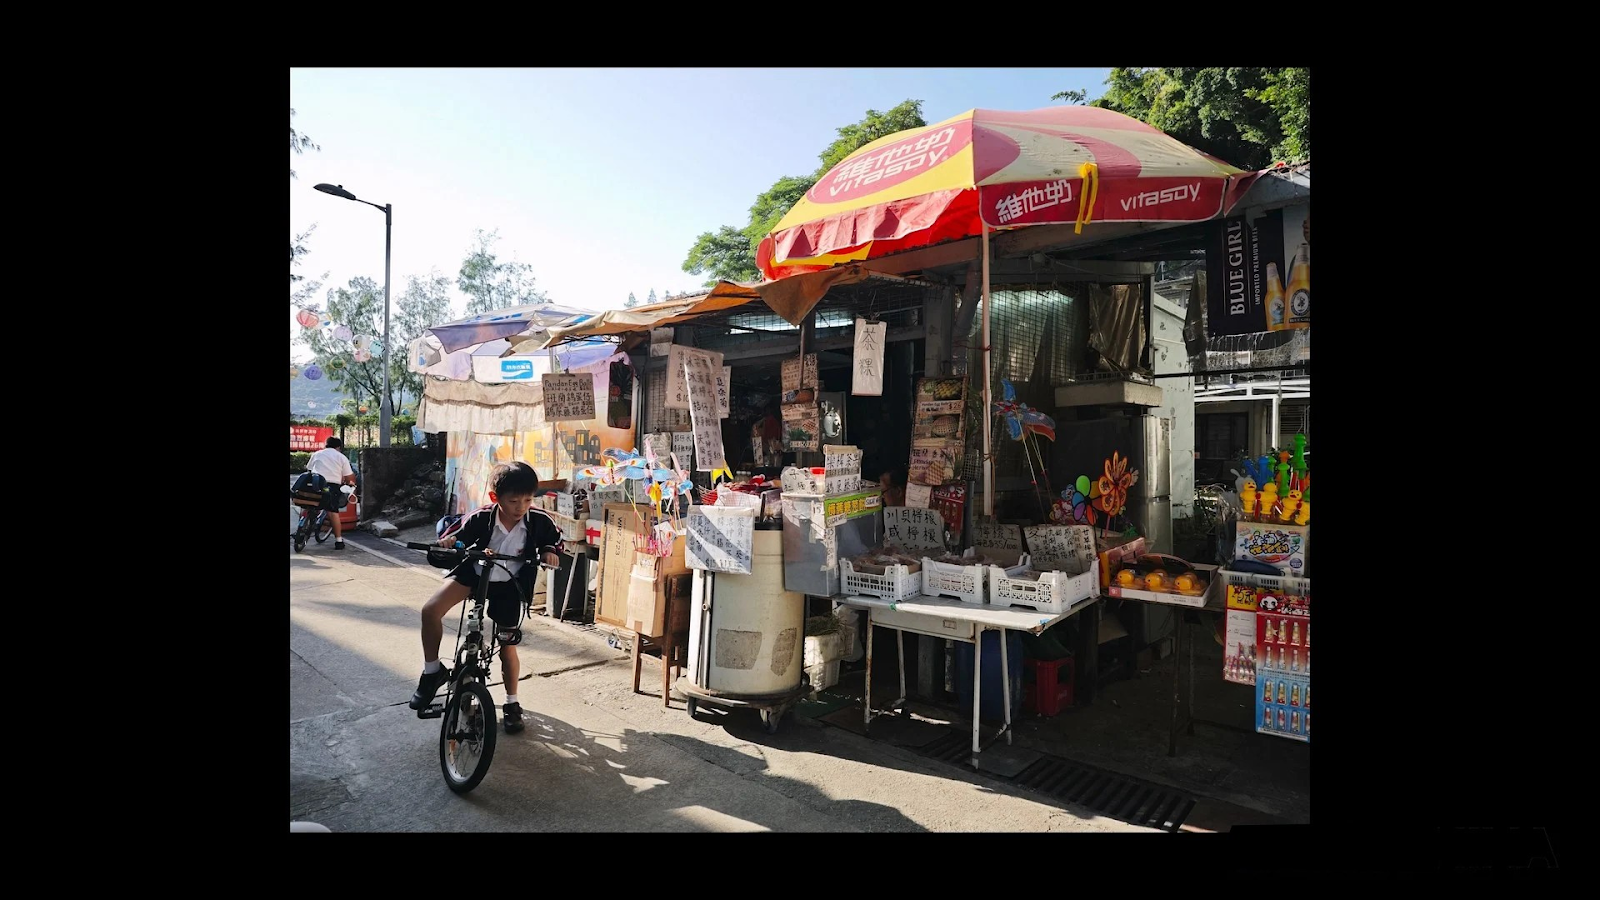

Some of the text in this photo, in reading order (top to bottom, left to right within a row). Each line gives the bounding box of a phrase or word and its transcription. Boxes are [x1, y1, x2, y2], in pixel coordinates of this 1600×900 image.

[834, 126, 956, 183] 維他奶
[995, 179, 1072, 222] 維他奶
[1228, 221, 1245, 315] BLUE GIRL
[858, 327, 879, 377] 茶粿
